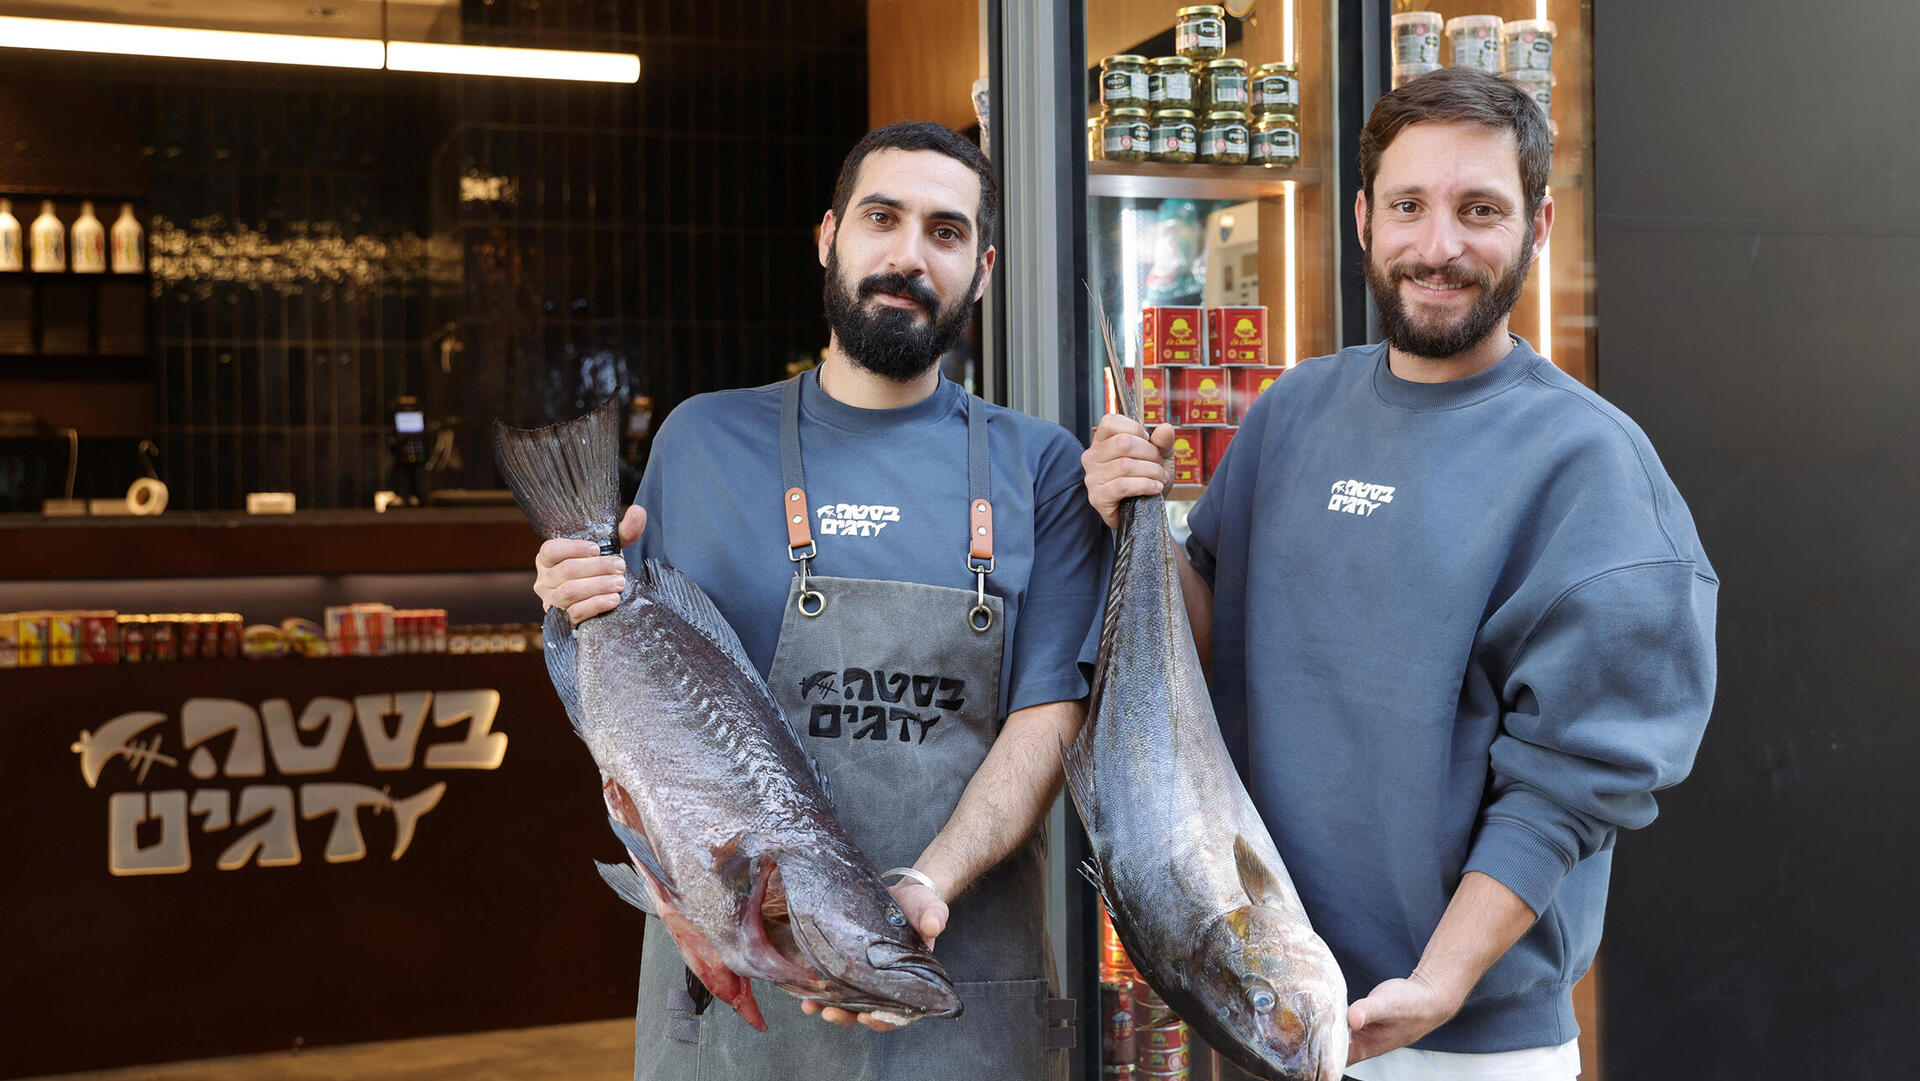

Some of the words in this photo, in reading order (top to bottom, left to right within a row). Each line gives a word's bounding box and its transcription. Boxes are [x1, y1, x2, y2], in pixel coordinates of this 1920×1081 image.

[1107, 78, 1125, 86] PONTI
[1344, 479, 1396, 504] בסטה
[836, 503, 901, 522] בסטה
[1327, 493, 1381, 517] דגים
[820, 518, 888, 537] דגים
[842, 667, 966, 712] בסטה
[180, 688, 509, 780] בסטה
[808, 703, 942, 745] דגים
[108, 781, 447, 877] דגים
